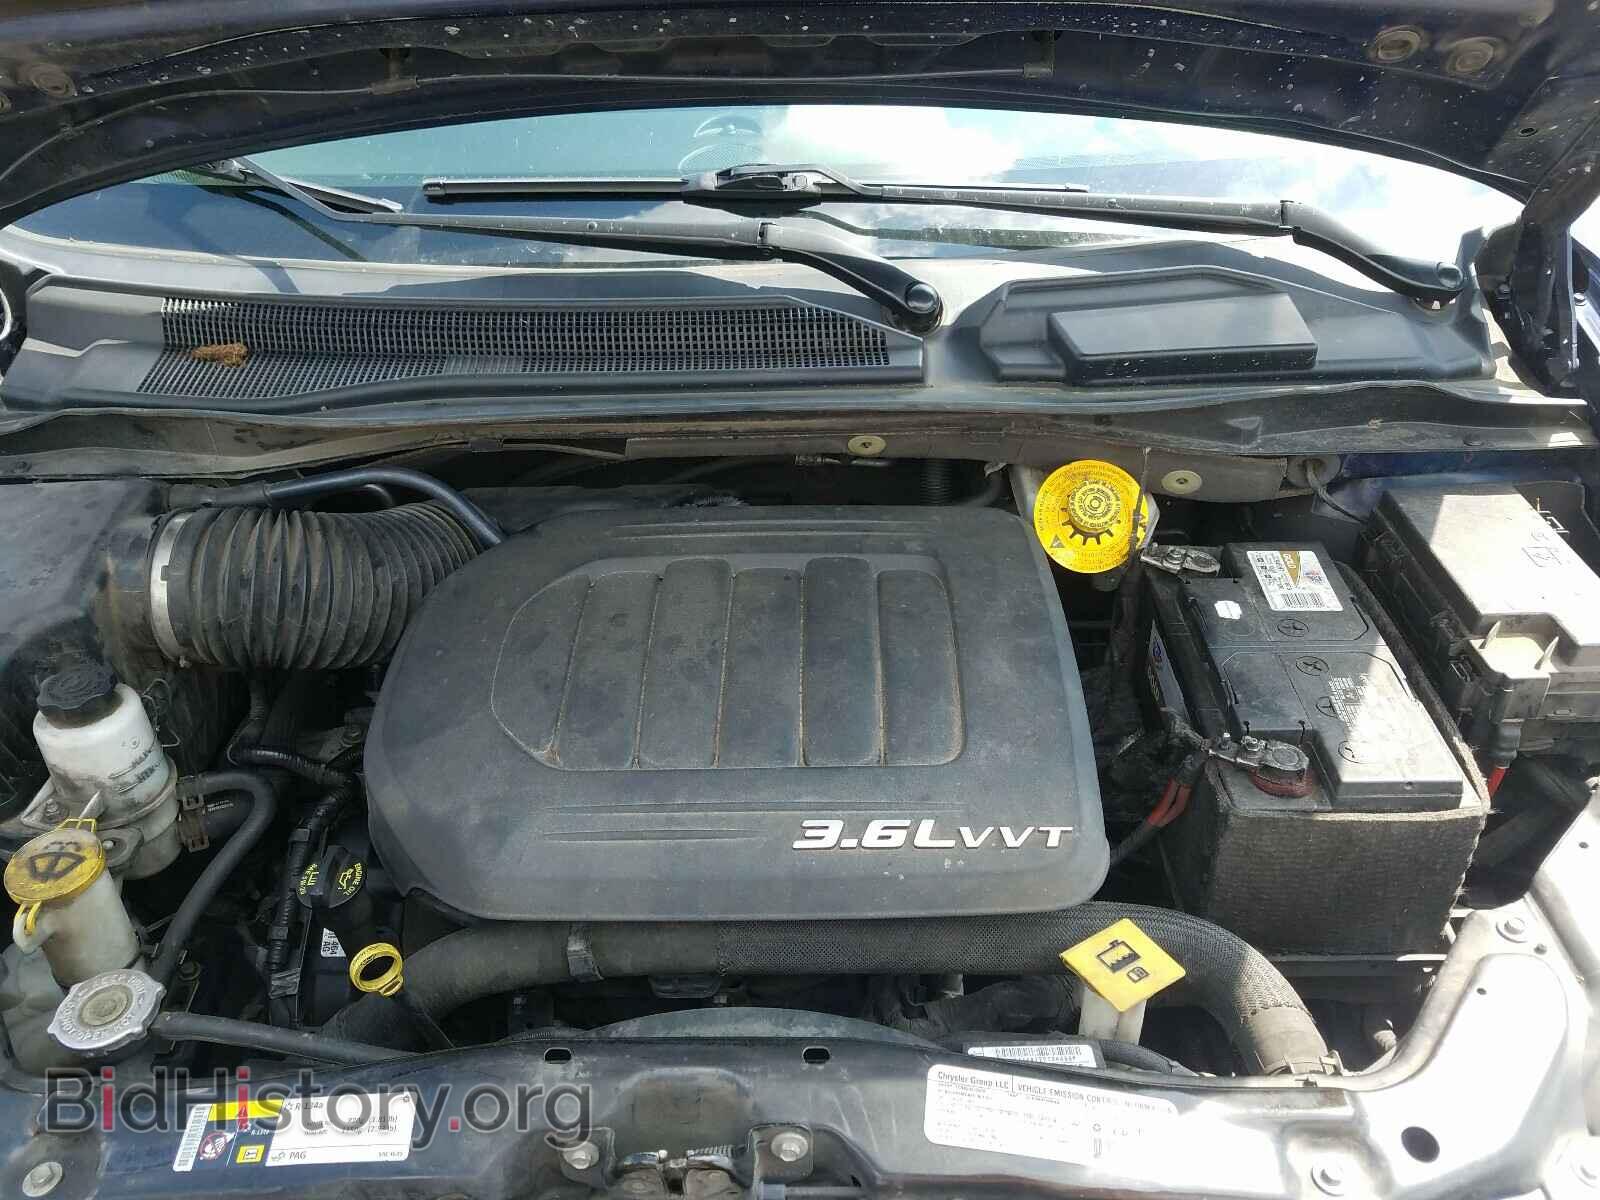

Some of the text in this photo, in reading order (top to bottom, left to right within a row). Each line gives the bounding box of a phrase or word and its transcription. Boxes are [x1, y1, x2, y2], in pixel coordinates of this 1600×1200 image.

[937, 1071, 1009, 1090] Chrysler Group LLC
[1018, 1083, 1047, 1095] VEHICLE
[1049, 1088, 1084, 1100] EMISSION
[289, 1151, 307, 1160] PAG
